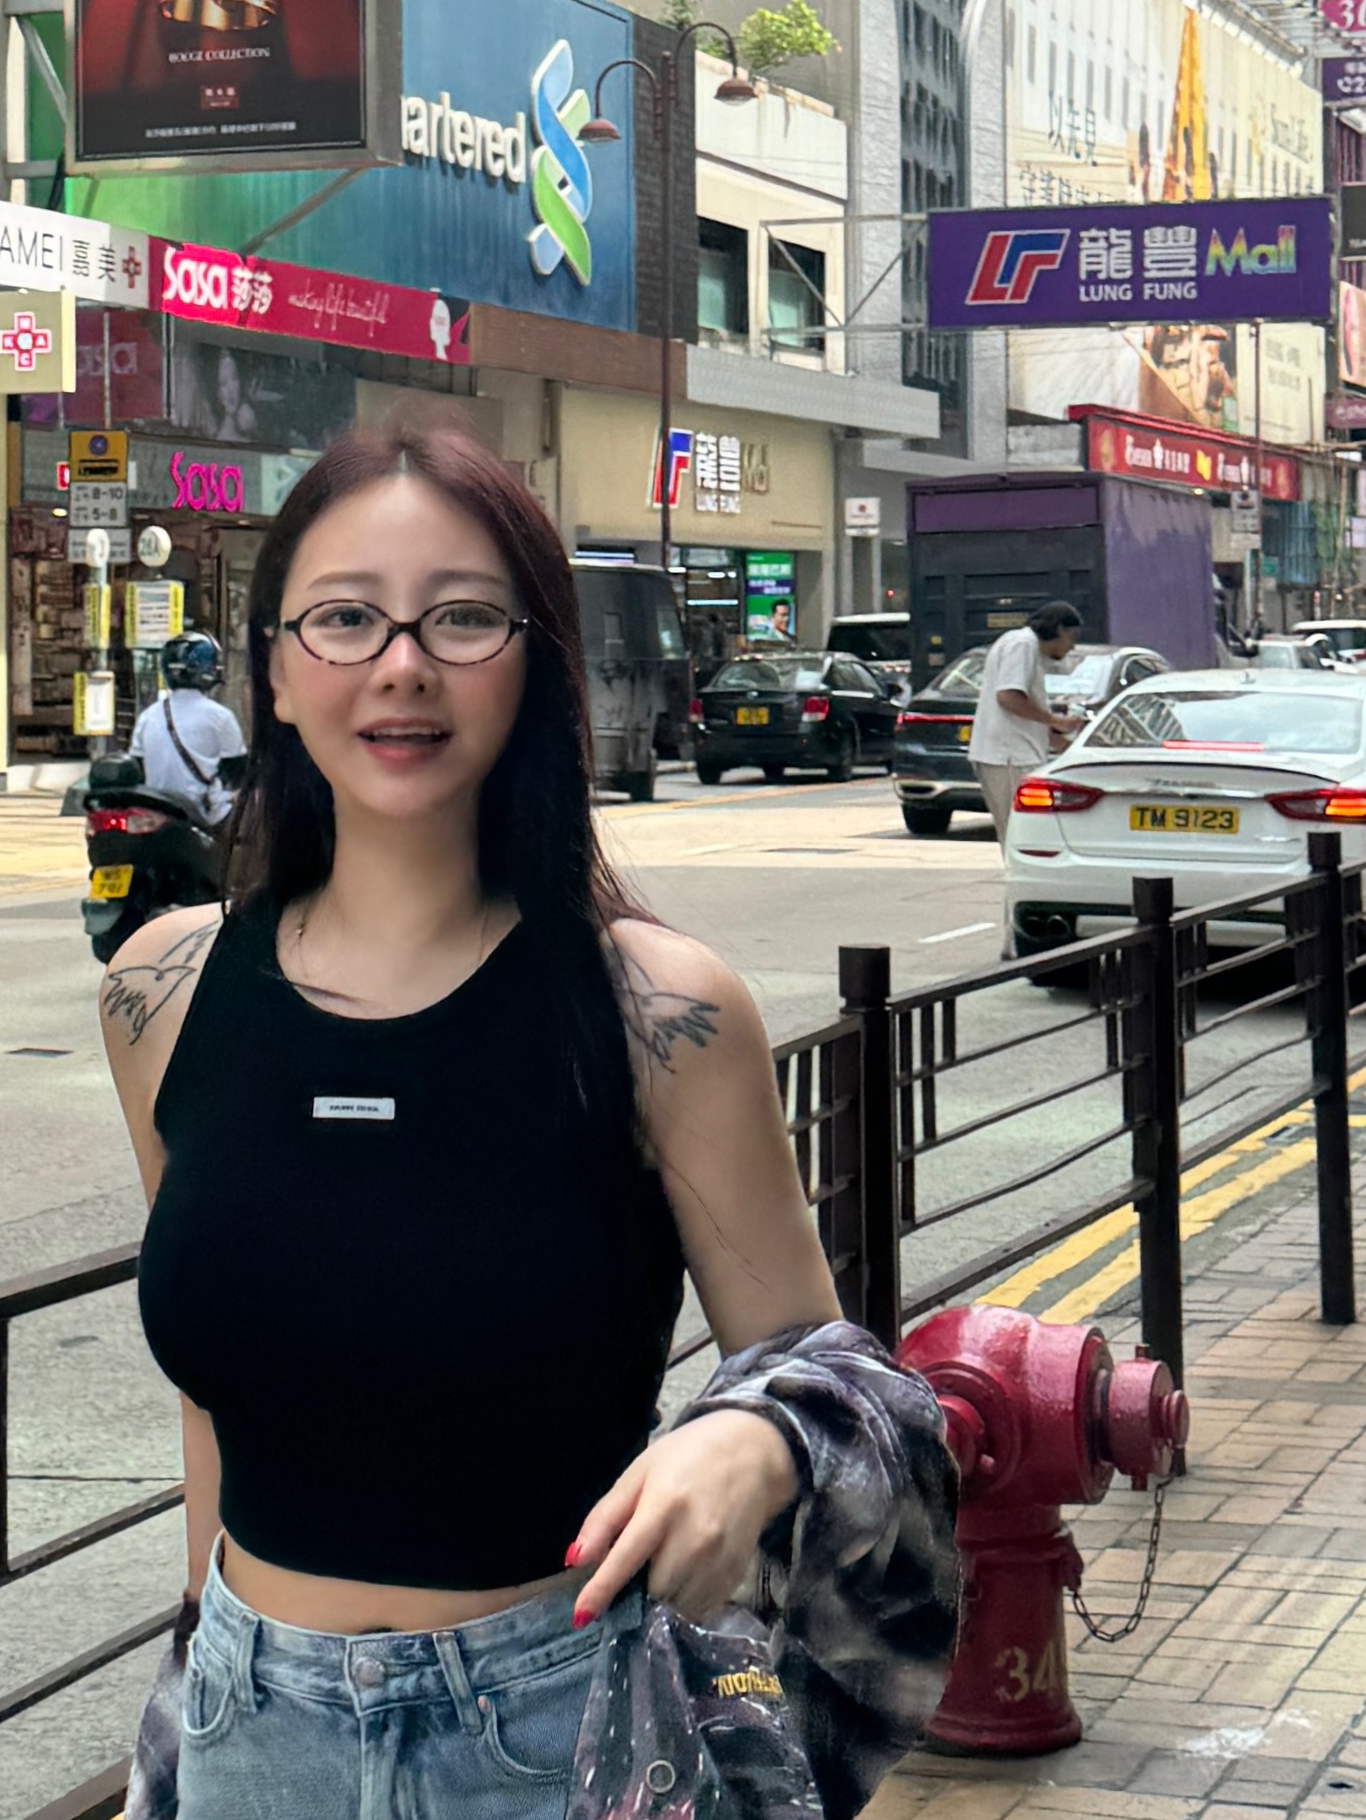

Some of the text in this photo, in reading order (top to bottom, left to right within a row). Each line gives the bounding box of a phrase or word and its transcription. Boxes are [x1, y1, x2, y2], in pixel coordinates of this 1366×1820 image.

[1078, 224, 1297, 281] 龍豐 Mall
[1079, 281, 1198, 302] LUNG FUNG
[1136, 807, 1167, 827] TM
